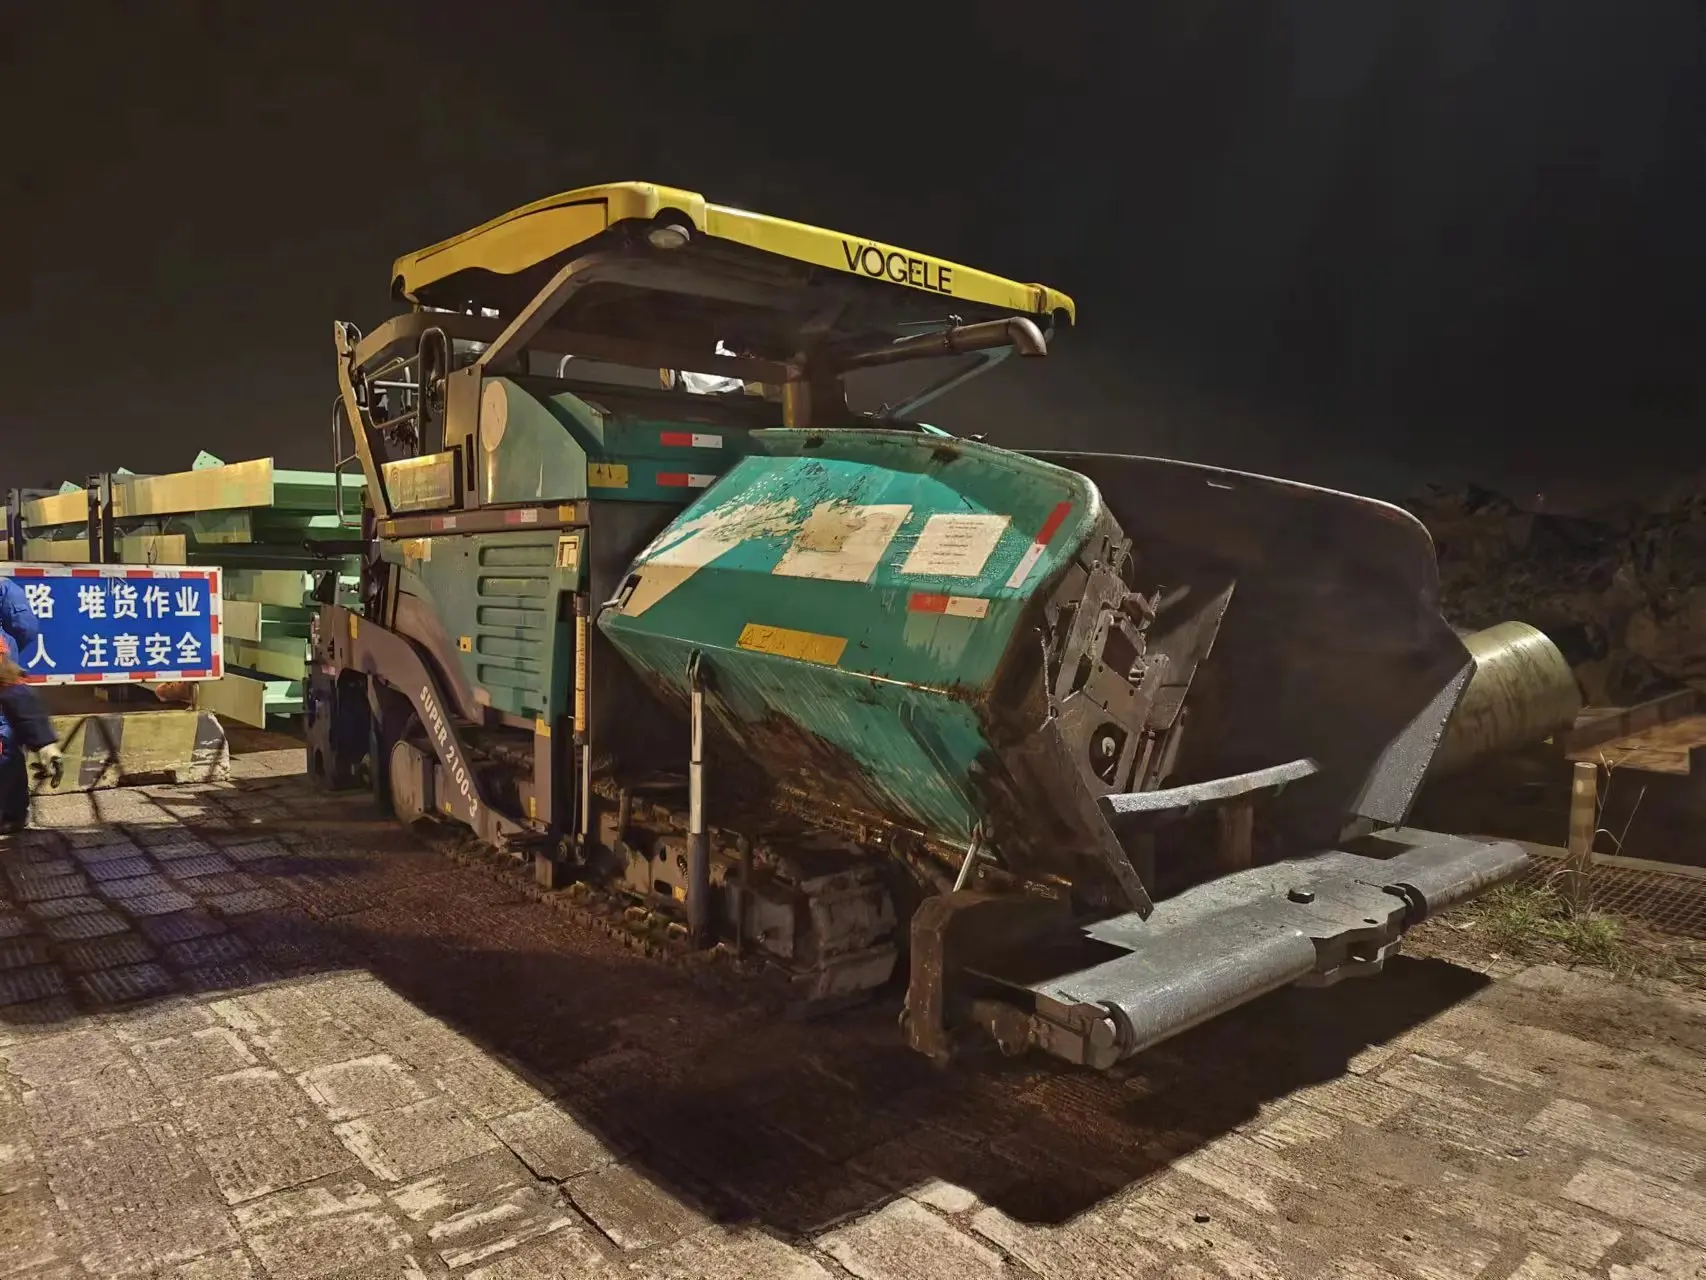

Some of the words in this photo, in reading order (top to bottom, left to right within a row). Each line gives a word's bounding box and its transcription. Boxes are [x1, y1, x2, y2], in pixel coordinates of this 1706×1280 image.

[25, 583, 55, 619] 路
[78, 584, 201, 619] 堆货作业
[27, 633, 57, 669] 人
[80, 632, 202, 668] 注意安全
[420, 686, 448, 747] SUPER
[445, 745, 478, 817] 2100-3
